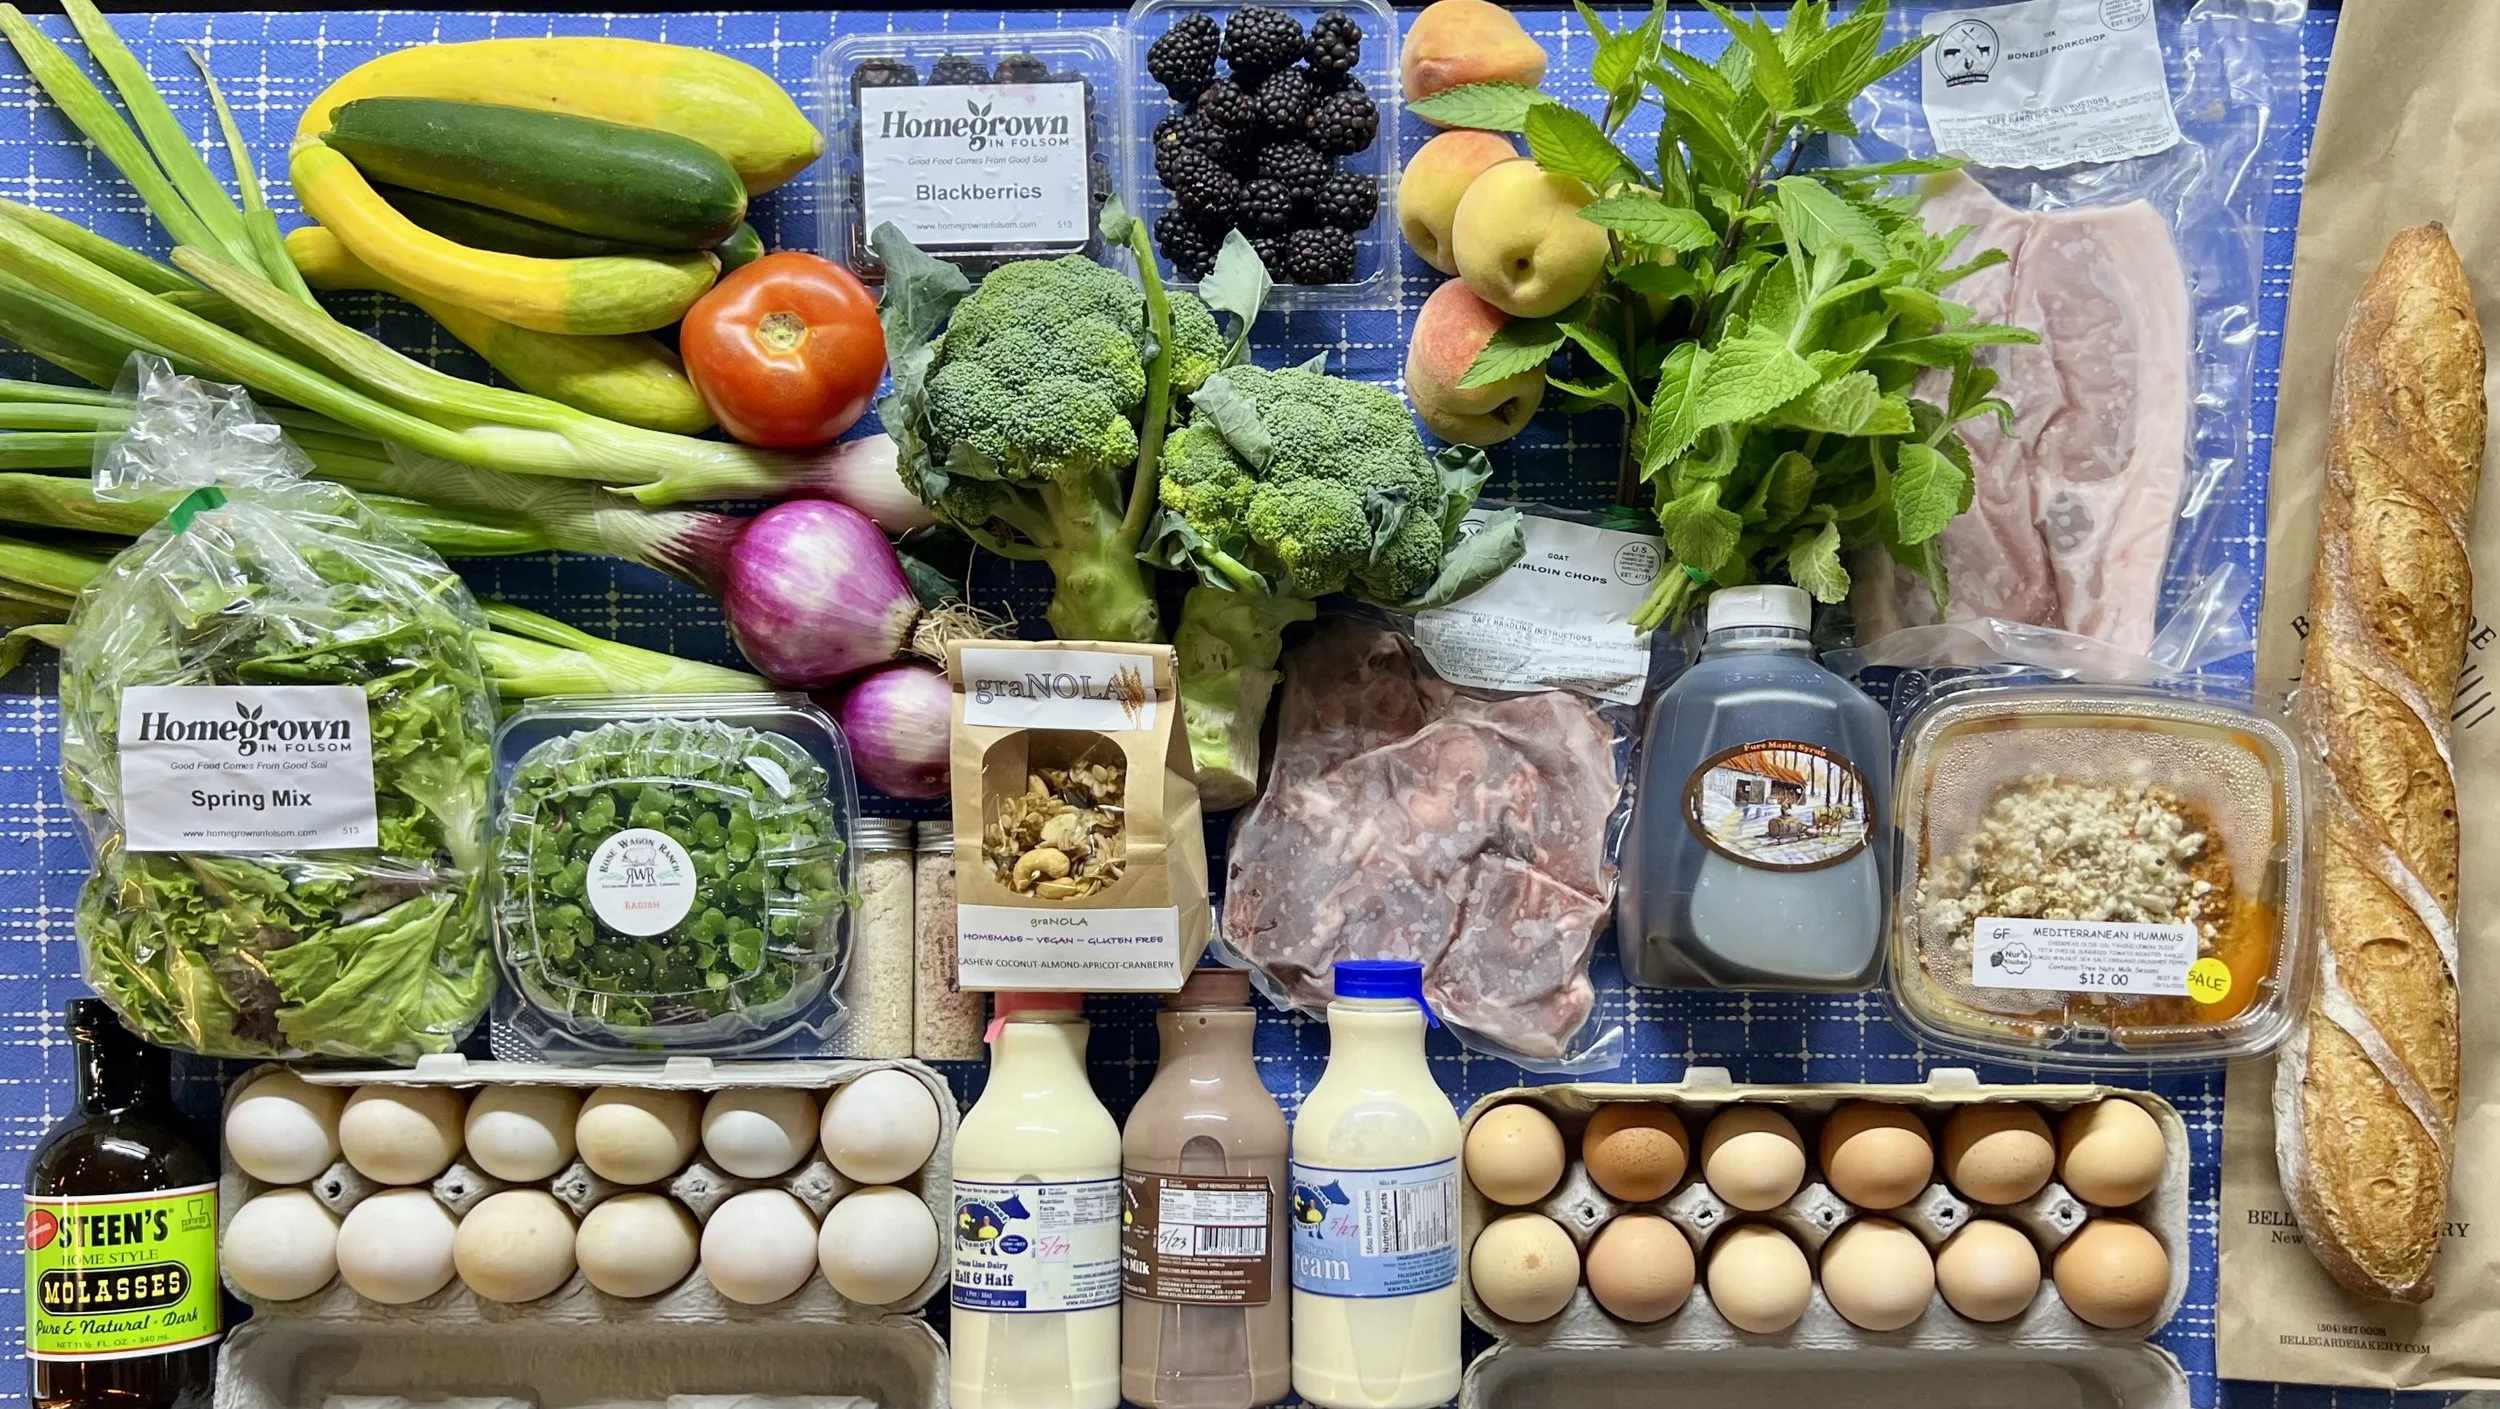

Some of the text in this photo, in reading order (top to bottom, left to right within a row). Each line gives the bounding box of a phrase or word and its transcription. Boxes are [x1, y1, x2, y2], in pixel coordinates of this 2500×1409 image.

[2051, 33, 2106, 52] PORKCHOP
[1987, 117, 2006, 125] SAFE
[2050, 96, 2109, 114] INSTRUCTIONS
[880, 110, 1069, 152] Homegrown
[989, 137, 1070, 148] IN FOLSOM
[908, 155, 1048, 166] Good Food Comes From Good Soil
[916, 182, 1042, 201] Blackberries
[1057, 220, 1073, 229] 513
[1547, 552, 1570, 562] GOAT
[1564, 571, 1608, 585] CHOPS
[1472, 616, 1593, 642] SAFE HANDLING INSTRUCTIONS
[975, 672, 1129, 705] graNOLA
[138, 711, 351, 757] Homegrown
[261, 742, 352, 752] IN FOLSOM
[1743, 741, 1827, 757] Pure Maple Syrup
[170, 760, 328, 770] Good Food Comes From Good Soil
[191, 789, 313, 811] Spring Mix
[342, 826, 360, 835] 513
[599, 837, 680, 873] ROSE WAGON RANCH
[624, 901, 660, 910] RADISH
[1030, 917, 1089, 927] graNOLA
[963, 933, 1164, 945] HOMEMADE VEGAN GLUTEN FREE
[1992, 928, 2011, 940] GF
[2033, 927, 2184, 942] MEDITERRANEAN HUMMUS
[2005, 949, 2028, 958] Nur's
[2080, 964, 2096, 972] Tree
[2079, 971, 2129, 986] $12.00
[2187, 970, 2227, 992] SALE
[58, 1209, 169, 1249] STEEN'S
[1364, 1214, 1374, 1236] Heavy
[1380, 1192, 1390, 1253] Nutrition Facts
[1160, 1227, 1187, 1250] 5/23
[2271, 1230, 2304, 1245] New
[62, 1248, 159, 1266] HOME STYLE
[987, 1261, 1009, 1271] Dairy
[1129, 1257, 1150, 1275] Milk
[1294, 1251, 1352, 1281] ream
[955, 1269, 1014, 1286] Half & Half
[44, 1271, 181, 1304] MOLASSES
[36, 1307, 198, 1336] Pure & Natural Dark
[2316, 1322, 2341, 1334] (504)
[56, 1341, 72, 1349] NET
[139, 1335, 155, 1344] 340
